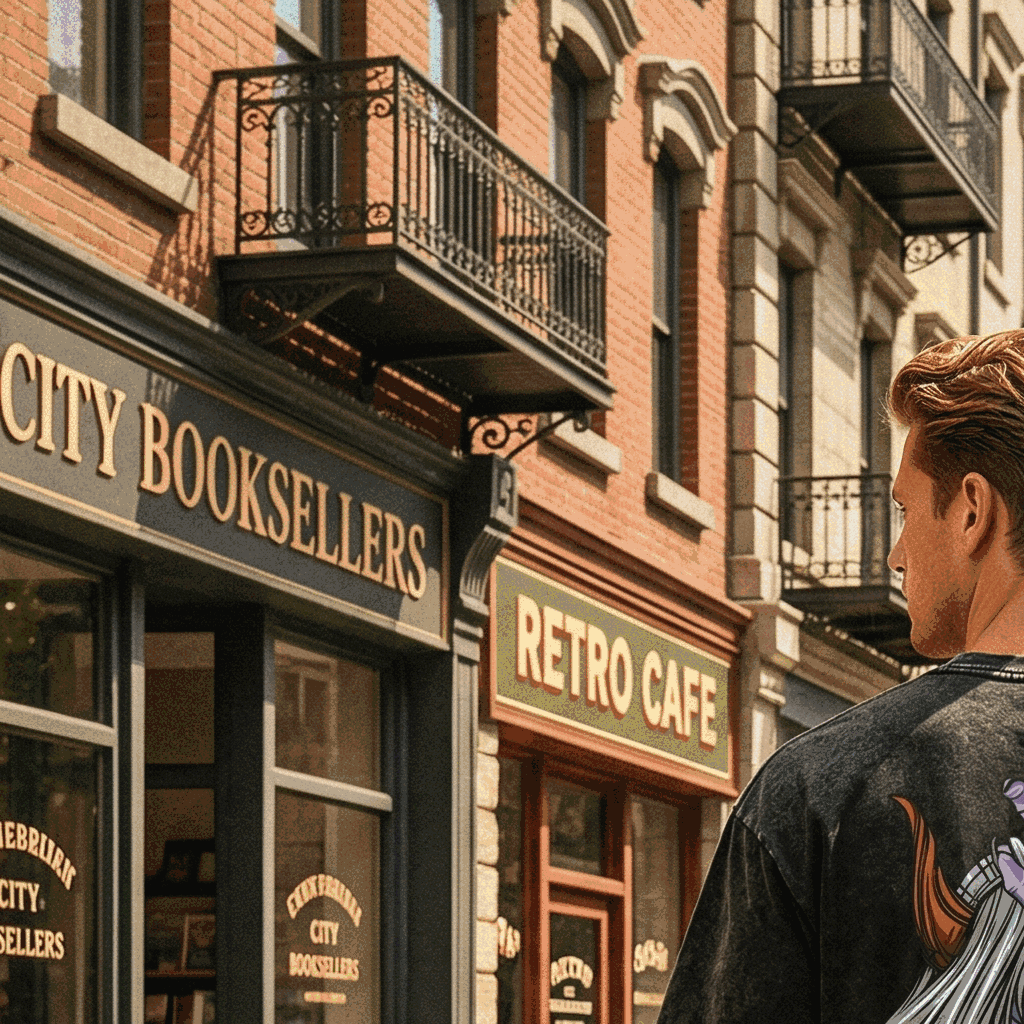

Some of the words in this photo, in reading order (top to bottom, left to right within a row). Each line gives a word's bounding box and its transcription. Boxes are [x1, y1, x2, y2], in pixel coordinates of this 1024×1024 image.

[0, 341, 127, 477] CITY
[139, 402, 427, 600] BOOKSELLERS
[517, 593, 634, 718] RETRO
[641, 649, 718, 748] CAFE
[0, 878, 40, 912] CITY
[310, 918, 340, 946] CITY
